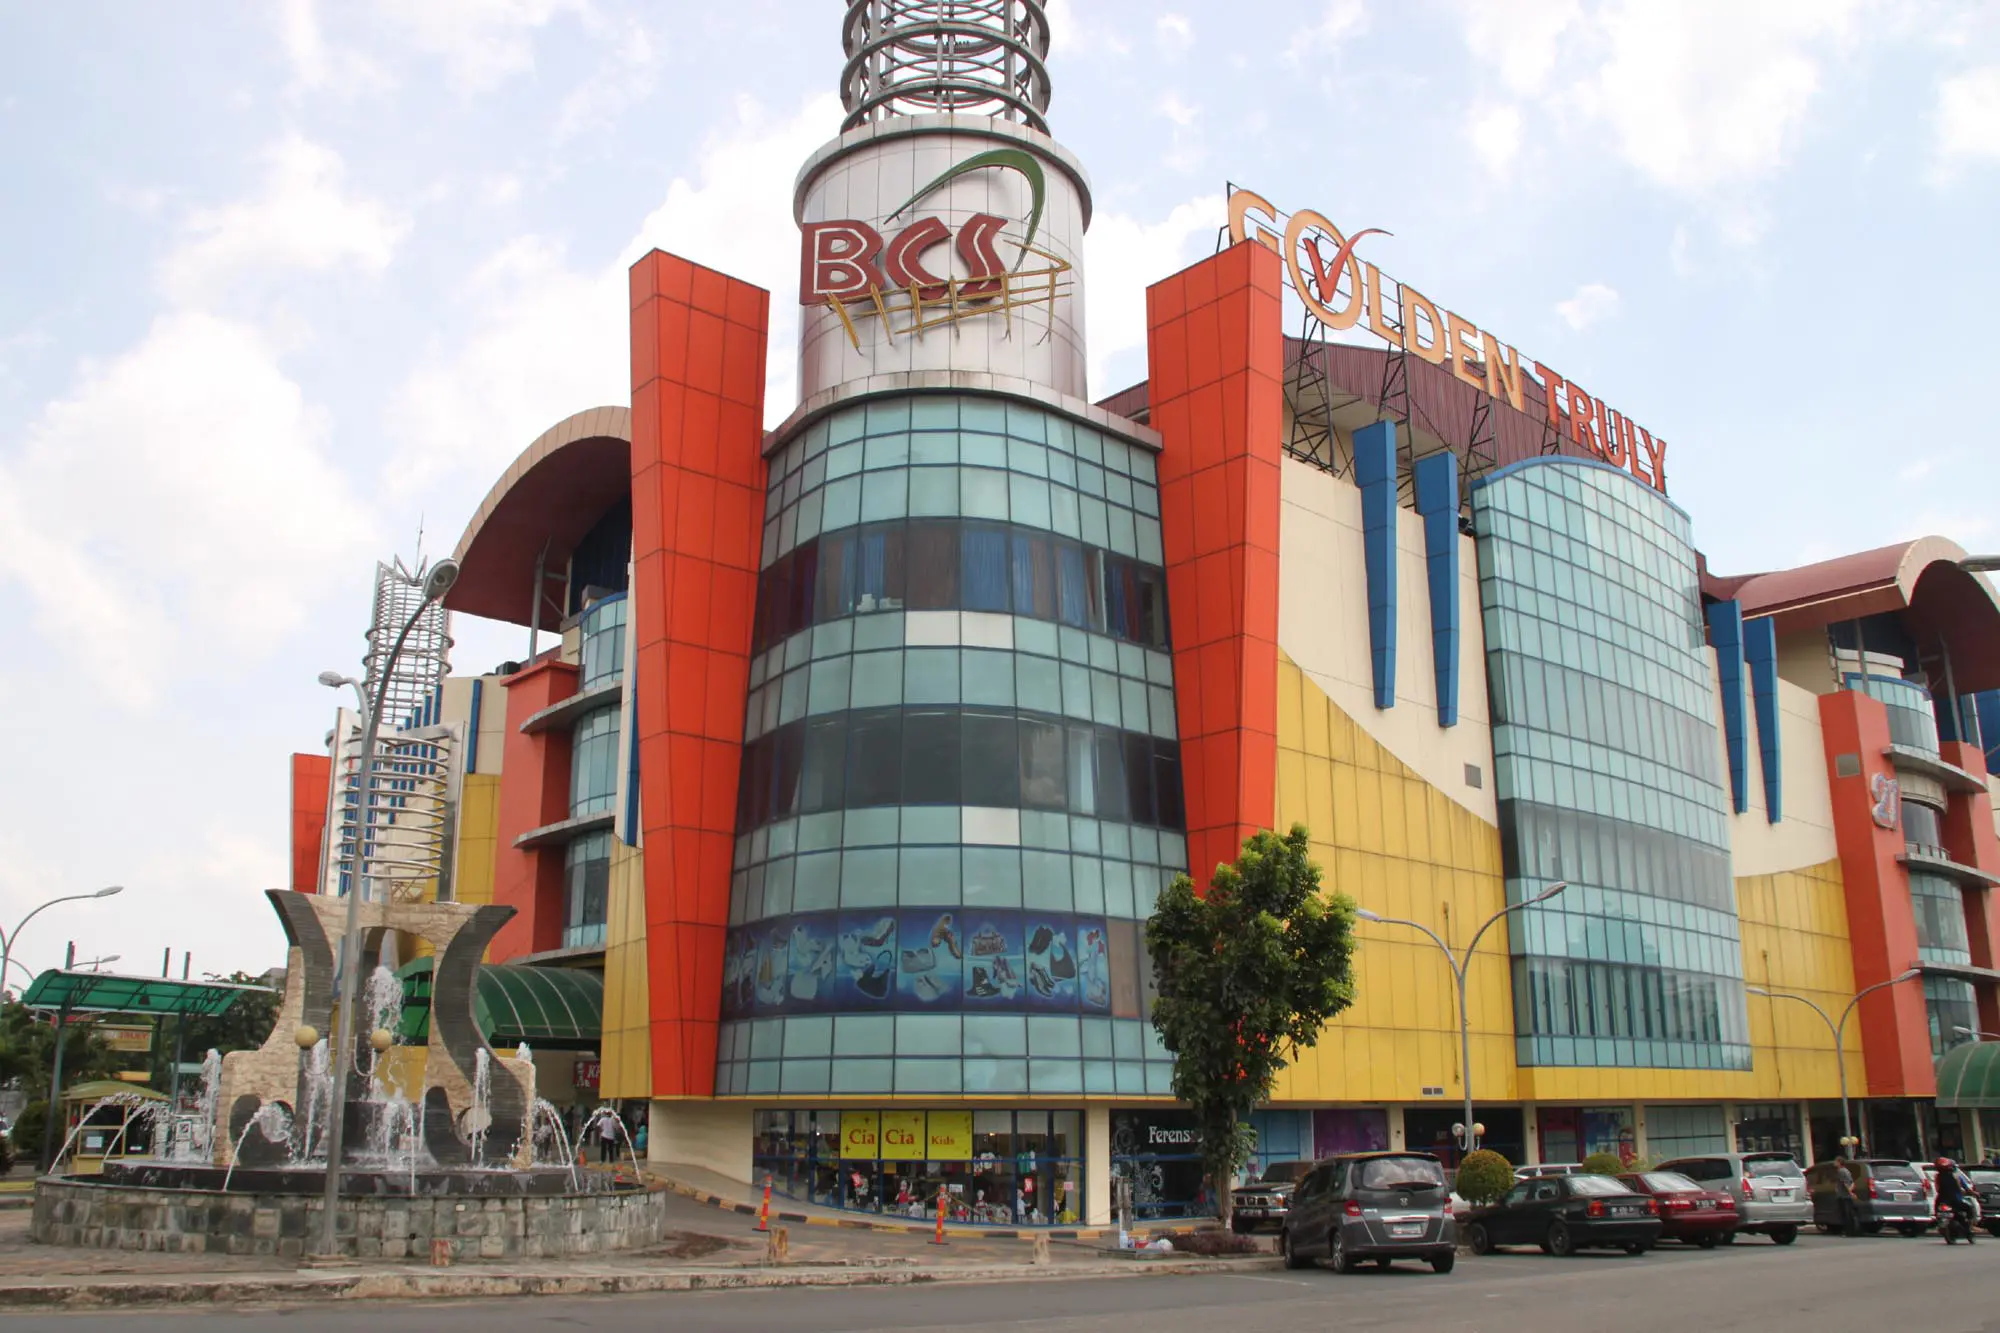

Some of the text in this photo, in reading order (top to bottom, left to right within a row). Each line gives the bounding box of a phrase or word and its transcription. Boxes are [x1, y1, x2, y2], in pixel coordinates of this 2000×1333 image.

[799, 212, 1008, 305] BCS
[1229, 188, 1667, 493] GOLDEN TRULY
[848, 1128, 955, 1146] Cia Cia Kids
